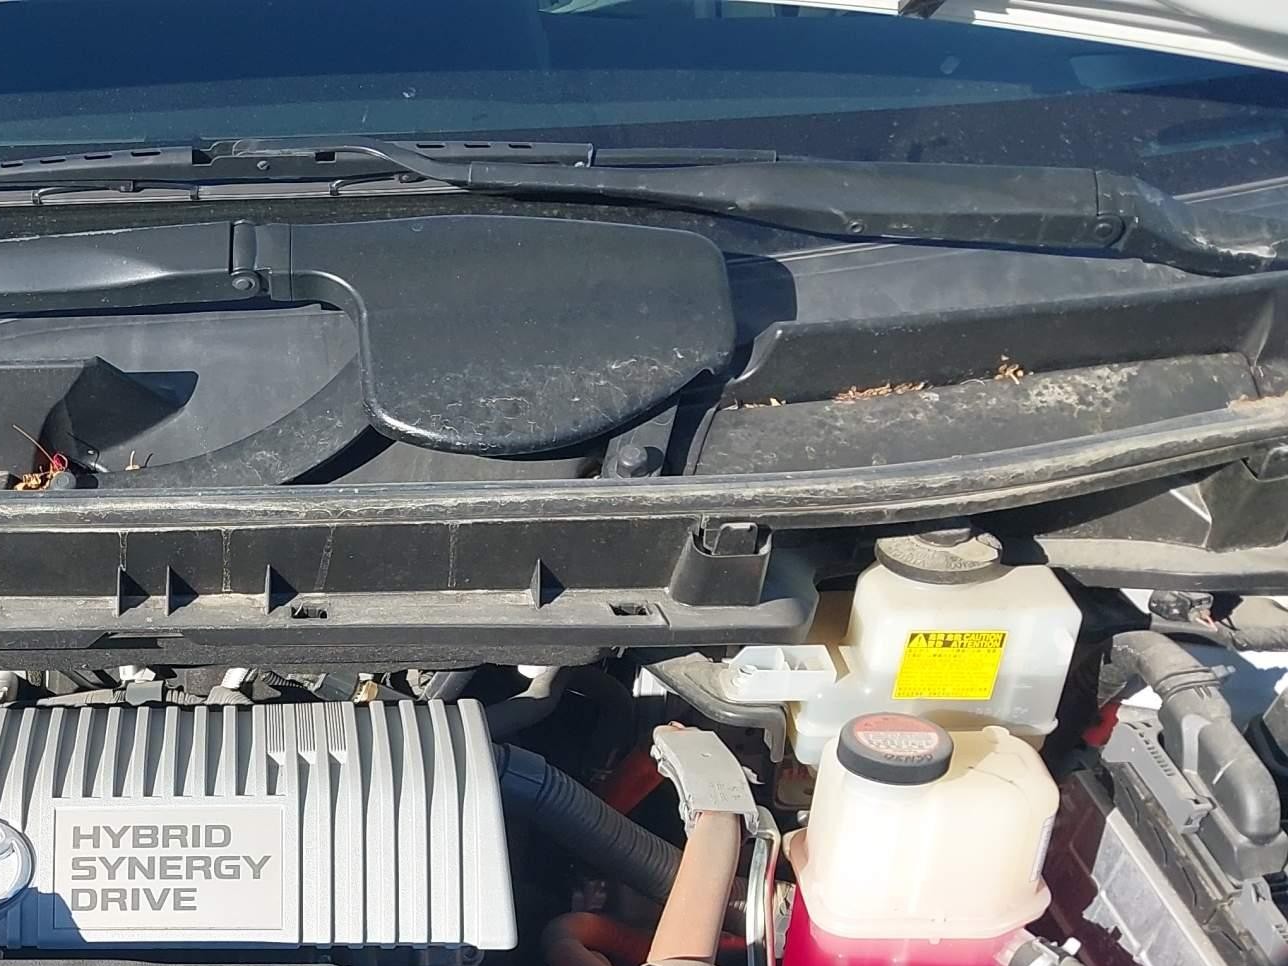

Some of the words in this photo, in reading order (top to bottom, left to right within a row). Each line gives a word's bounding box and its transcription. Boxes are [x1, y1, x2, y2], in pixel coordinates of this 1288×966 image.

[72, 824, 232, 849] HYBRID
[71, 855, 272, 881] SYNERGY
[70, 887, 197, 912] DRIVE
